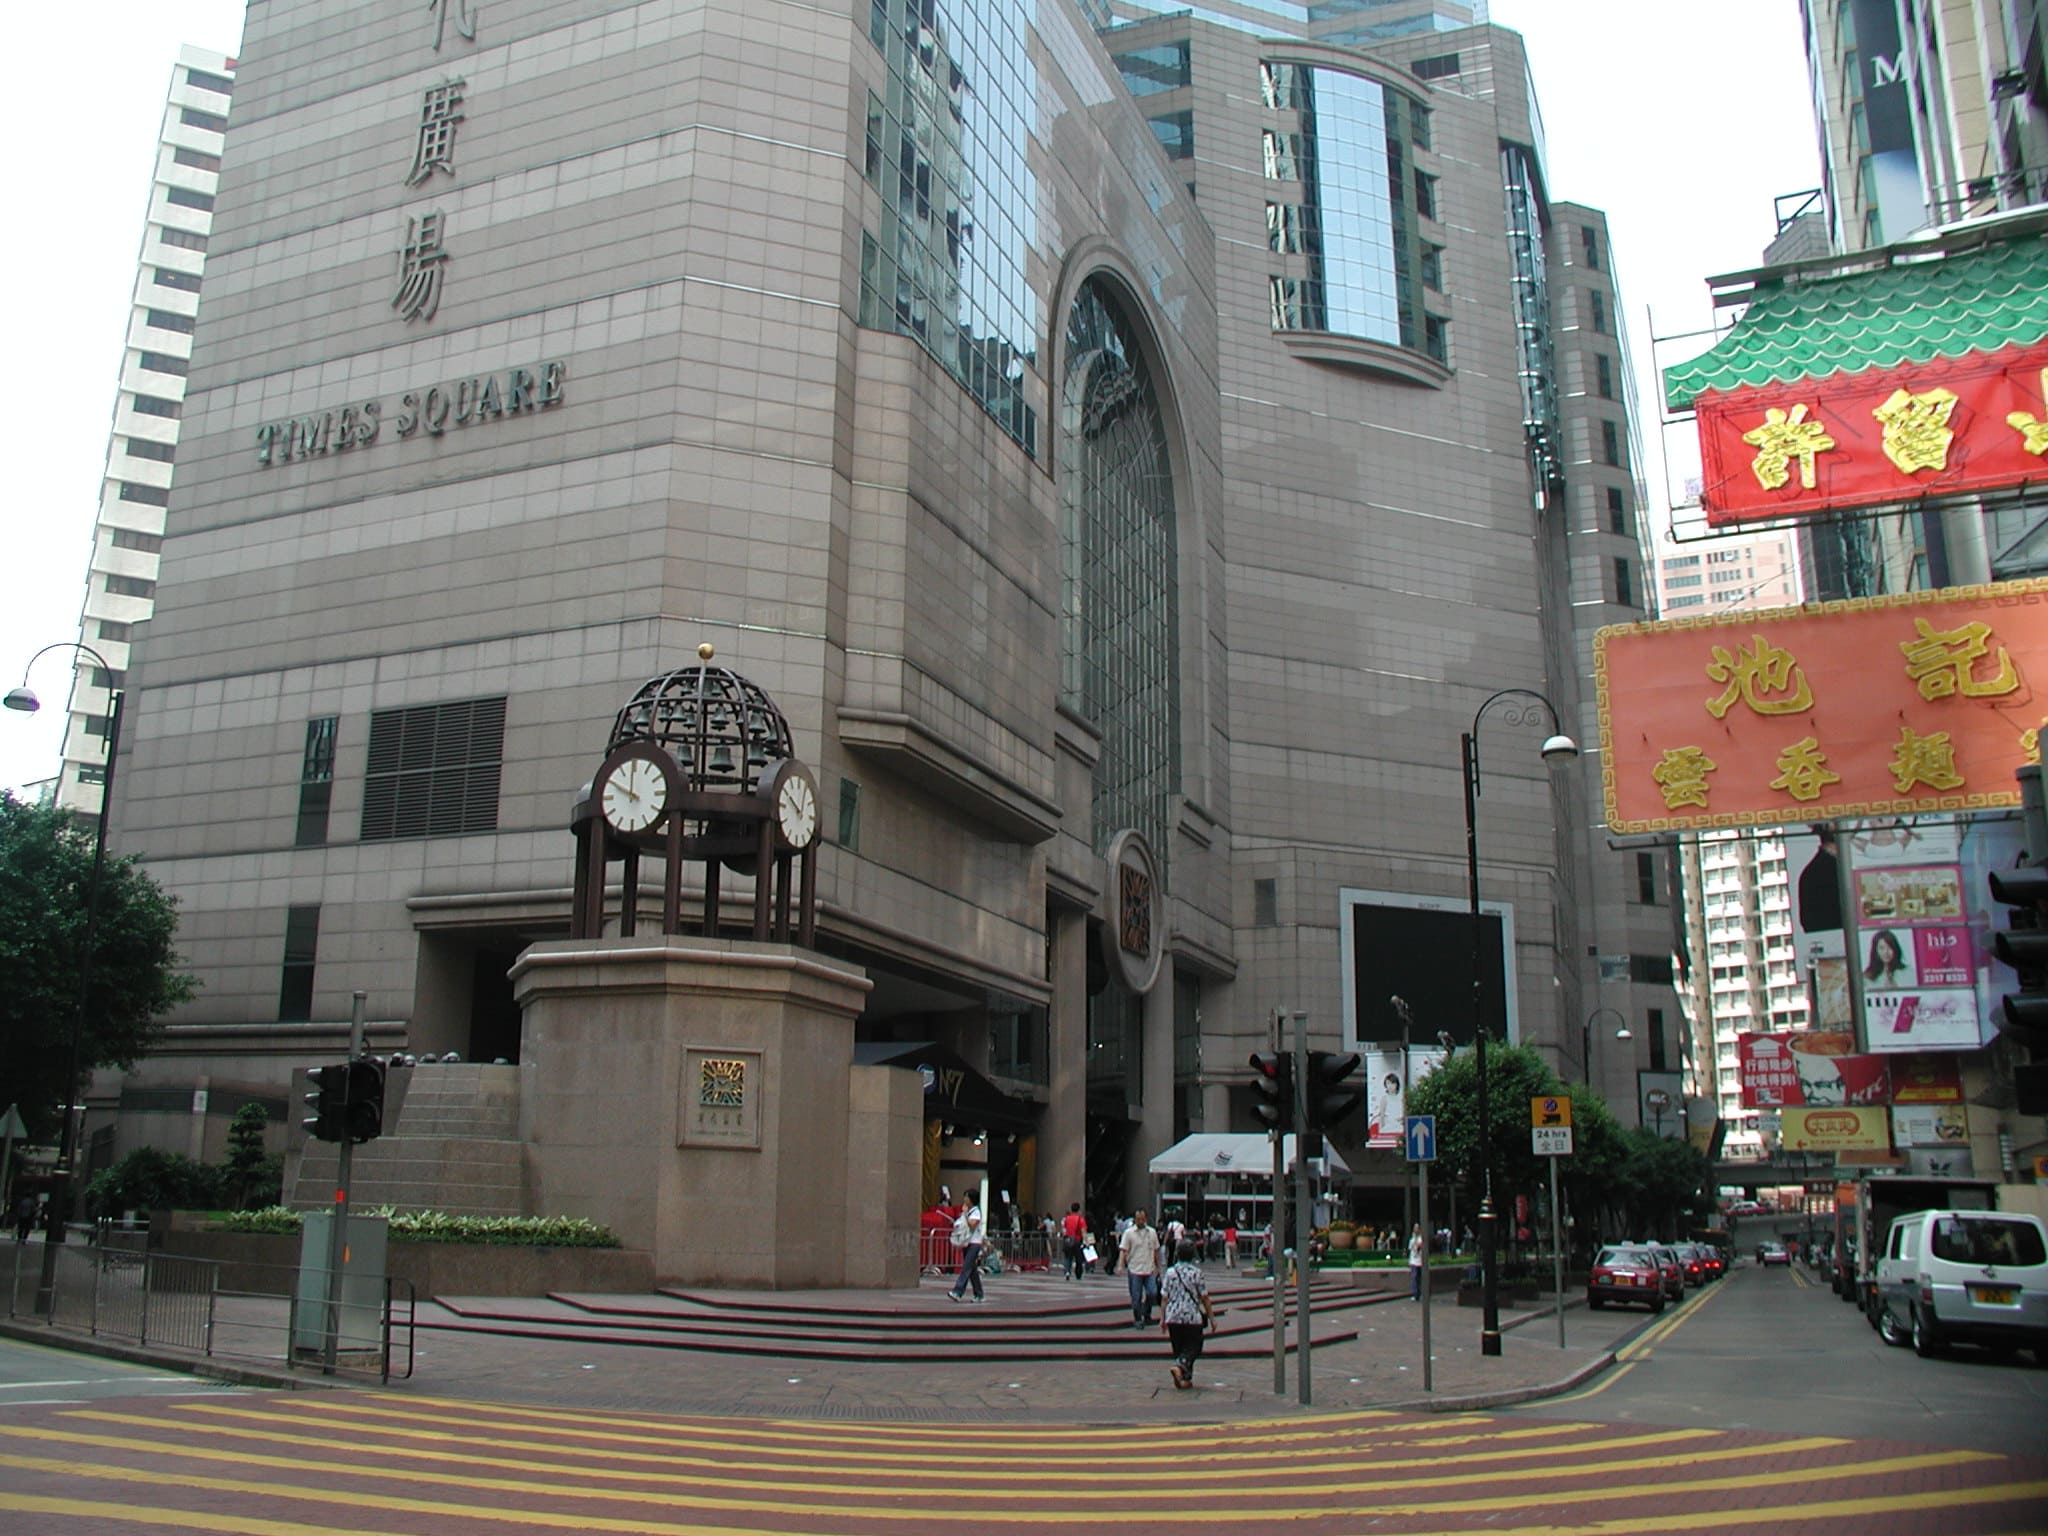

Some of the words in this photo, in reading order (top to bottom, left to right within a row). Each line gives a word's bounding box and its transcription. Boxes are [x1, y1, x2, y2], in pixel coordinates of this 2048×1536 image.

[256, 401, 382, 466] TIMES
[395, 359, 567, 438] SQUARE
[1742, 367, 2048, 491] 許留
[1705, 618, 2020, 719] 池記
[1652, 716, 2048, 811] 雲吞麵
[1537, 1130, 1549, 1139] 24
[1552, 1130, 1567, 1139] hrs
[1541, 1140, 1565, 1151] 全日
